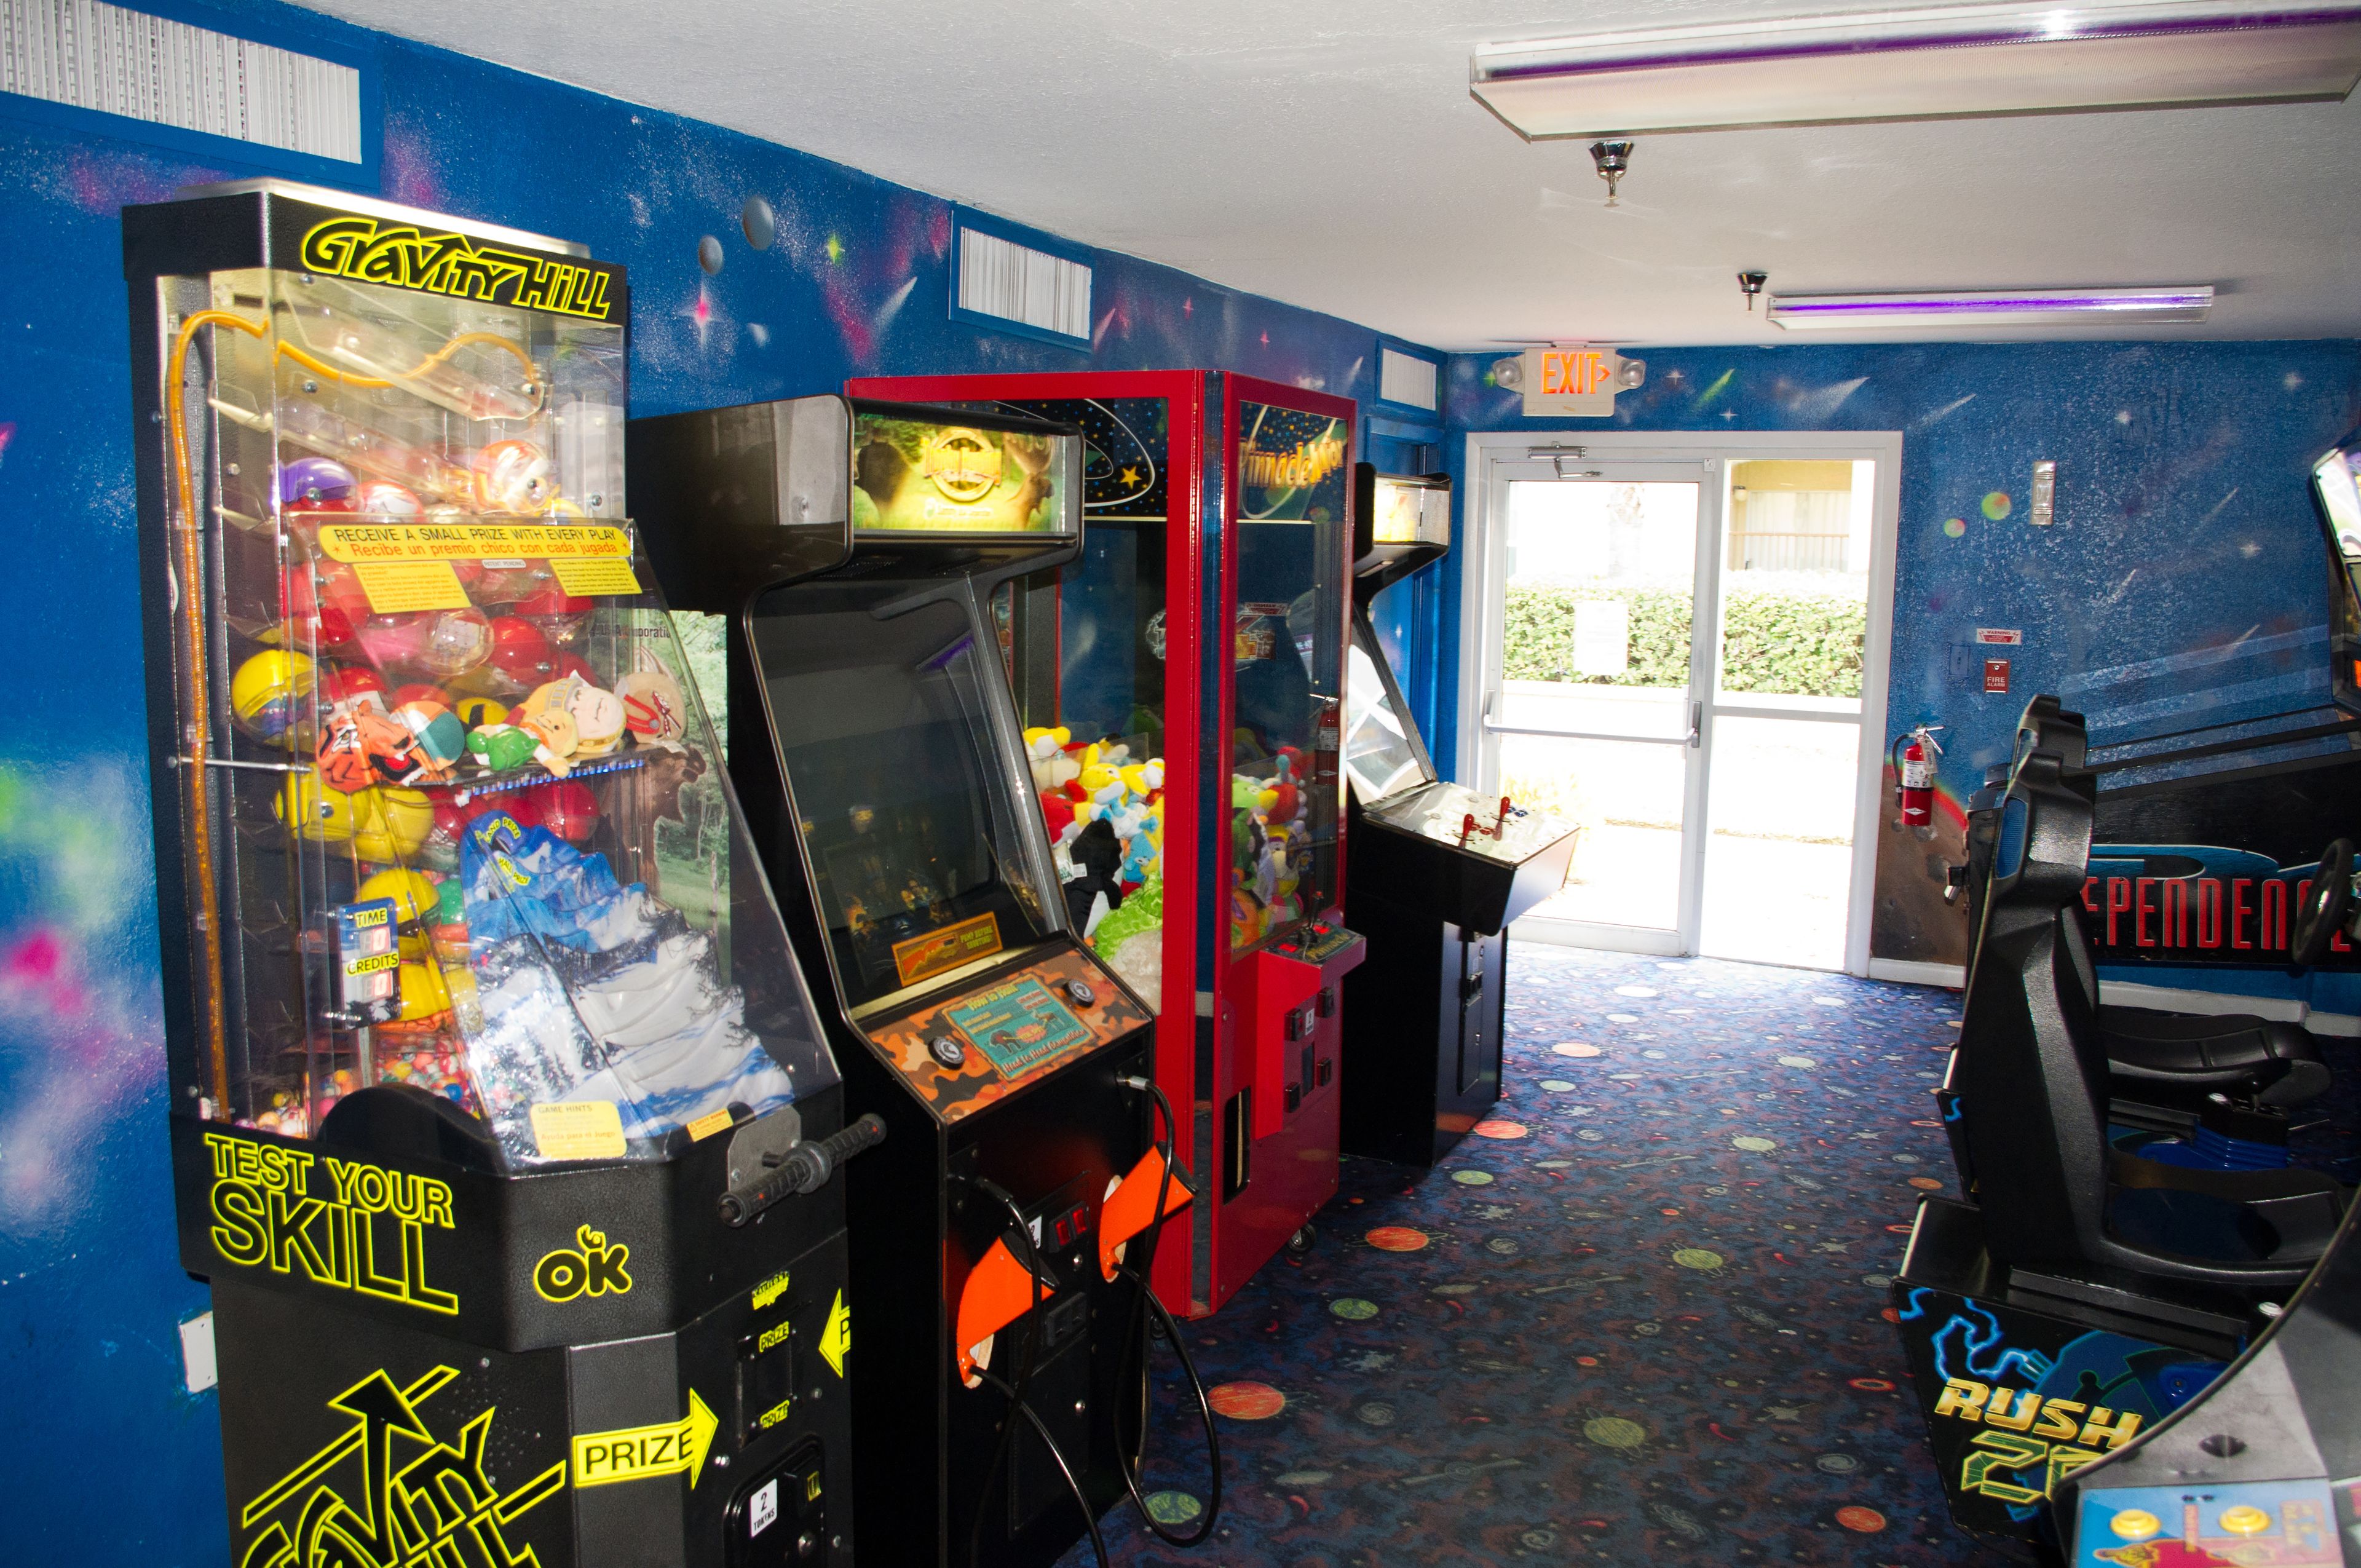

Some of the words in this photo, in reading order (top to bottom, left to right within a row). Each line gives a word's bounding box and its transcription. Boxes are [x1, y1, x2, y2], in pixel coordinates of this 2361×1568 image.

[1541, 352, 1602, 394] EXIT
[334, 529, 400, 541] RECEIVE
[406, 529, 416, 540] A
[422, 528, 467, 540] SMALL
[472, 529, 508, 540] PRIZE
[512, 529, 544, 540] WITH
[548, 529, 585, 540] EVERY
[590, 529, 615, 540] PLAY
[350, 544, 403, 556] Recibe
[408, 545, 425, 555] un
[430, 544, 477, 556] premio
[481, 542, 515, 554] chico
[520, 544, 542, 553] con
[547, 542, 575, 553] cada
[580, 542, 617, 554] jugada
[502, 817, 521, 839] PRIZE
[356, 909, 387, 926] TIME
[347, 954, 398, 974] CREDITS
[967, 996, 989, 1011] How
[1002, 1058, 1024, 1073] Head
[1030, 1045, 1050, 1059] Head
[541, 1131, 564, 1140] Ayuda
[204, 1132, 314, 1195] TEST
[326, 1157, 456, 1229] YOUR
[211, 1178, 459, 1315] SKILL
[533, 1224, 633, 1302] OK
[759, 1322, 789, 1351] PRIZE
[1934, 1377, 2143, 1449] RUSH
[585, 1427, 693, 1475] PRIZE
[760, 1492, 767, 1512] 2
[753, 1507, 775, 1531] TOKENS
